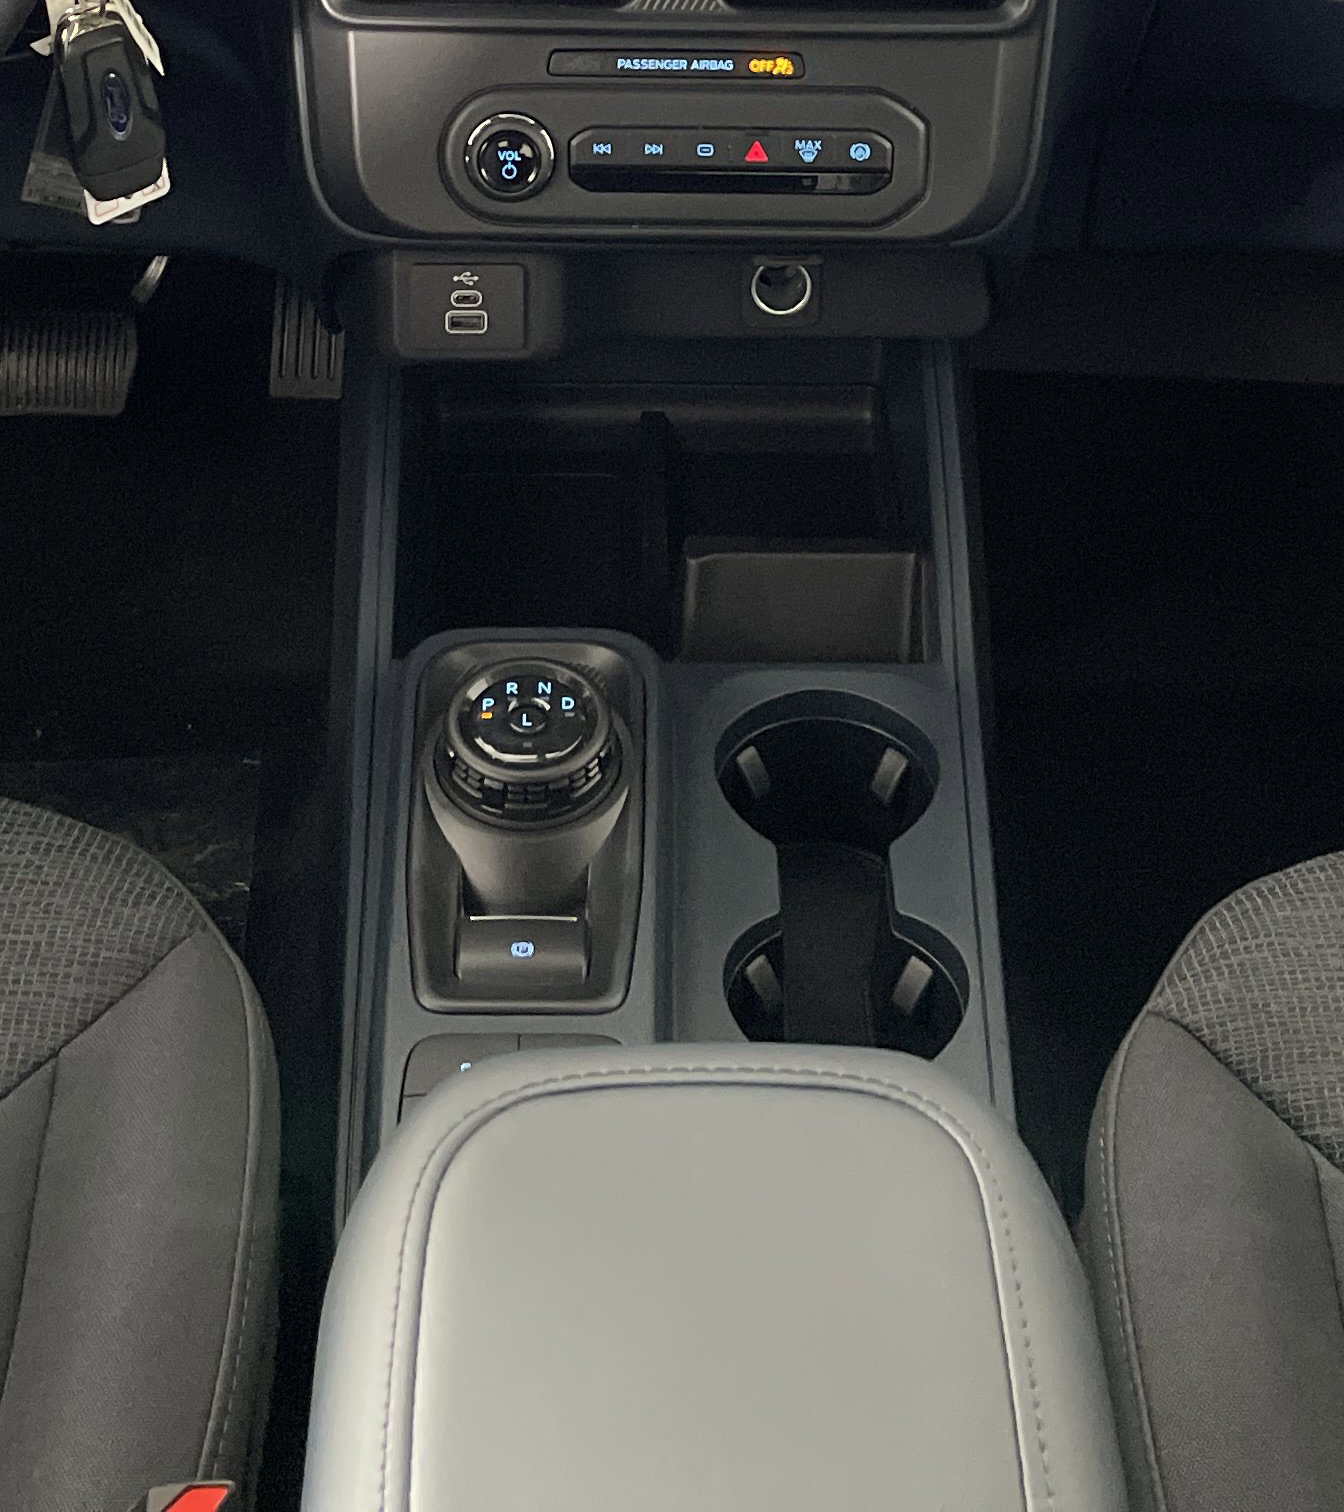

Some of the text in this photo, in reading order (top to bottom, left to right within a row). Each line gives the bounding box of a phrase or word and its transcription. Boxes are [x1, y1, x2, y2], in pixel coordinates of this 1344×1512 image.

[617, 58, 734, 72] PASSENGER AIRBAG
[748, 58, 774, 74] OFF
[794, 139, 822, 152] MAX
[497, 149, 522, 163] VOL
[506, 681, 519, 695] R
[537, 681, 552, 695] N
[482, 697, 495, 711] P
[561, 696, 575, 710] D
[522, 713, 533, 727] L
